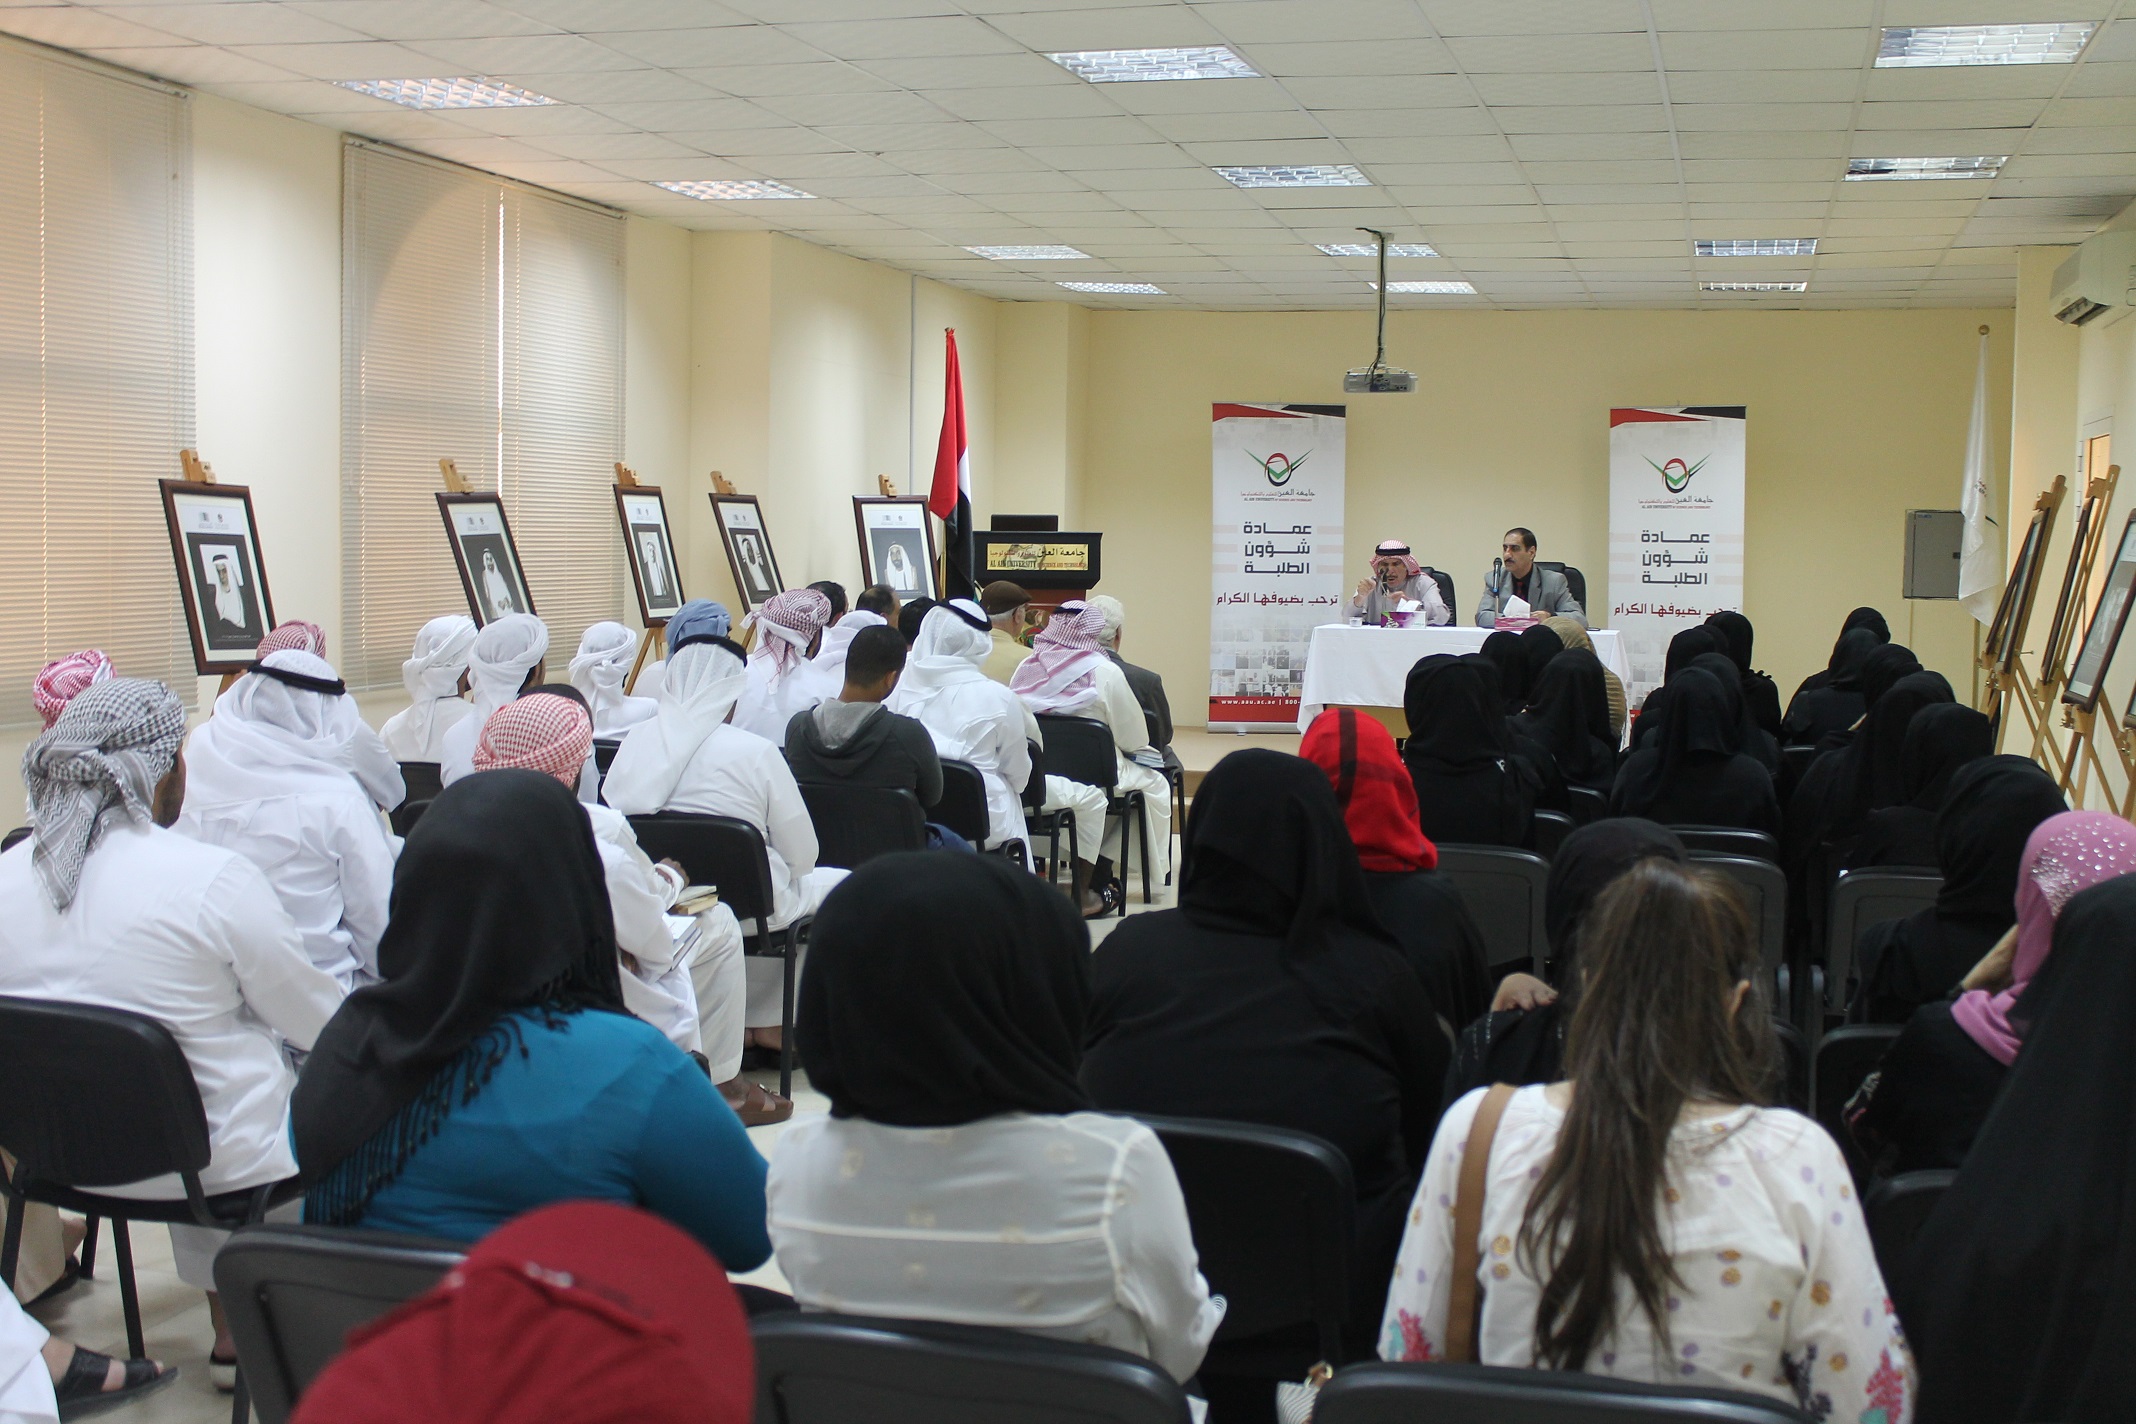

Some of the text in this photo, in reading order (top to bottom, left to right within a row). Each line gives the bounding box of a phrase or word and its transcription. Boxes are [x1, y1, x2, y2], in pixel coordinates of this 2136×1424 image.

[1243, 521, 1312, 535] عمادة
[1641, 529, 1710, 544] عمادة
[1059, 547, 1086, 558] جامعة
[1244, 538, 1310, 558] شؤون
[1642, 547, 1708, 568] شؤون
[1244, 561, 1310, 577] الطلبة
[1642, 571, 1708, 588] الطلبة
[1216, 591, 1339, 606] ترحب بضيوفها الكرام
[1613, 602, 1647, 616] الكرام
[1651, 602, 1701, 618] بضيوفها
